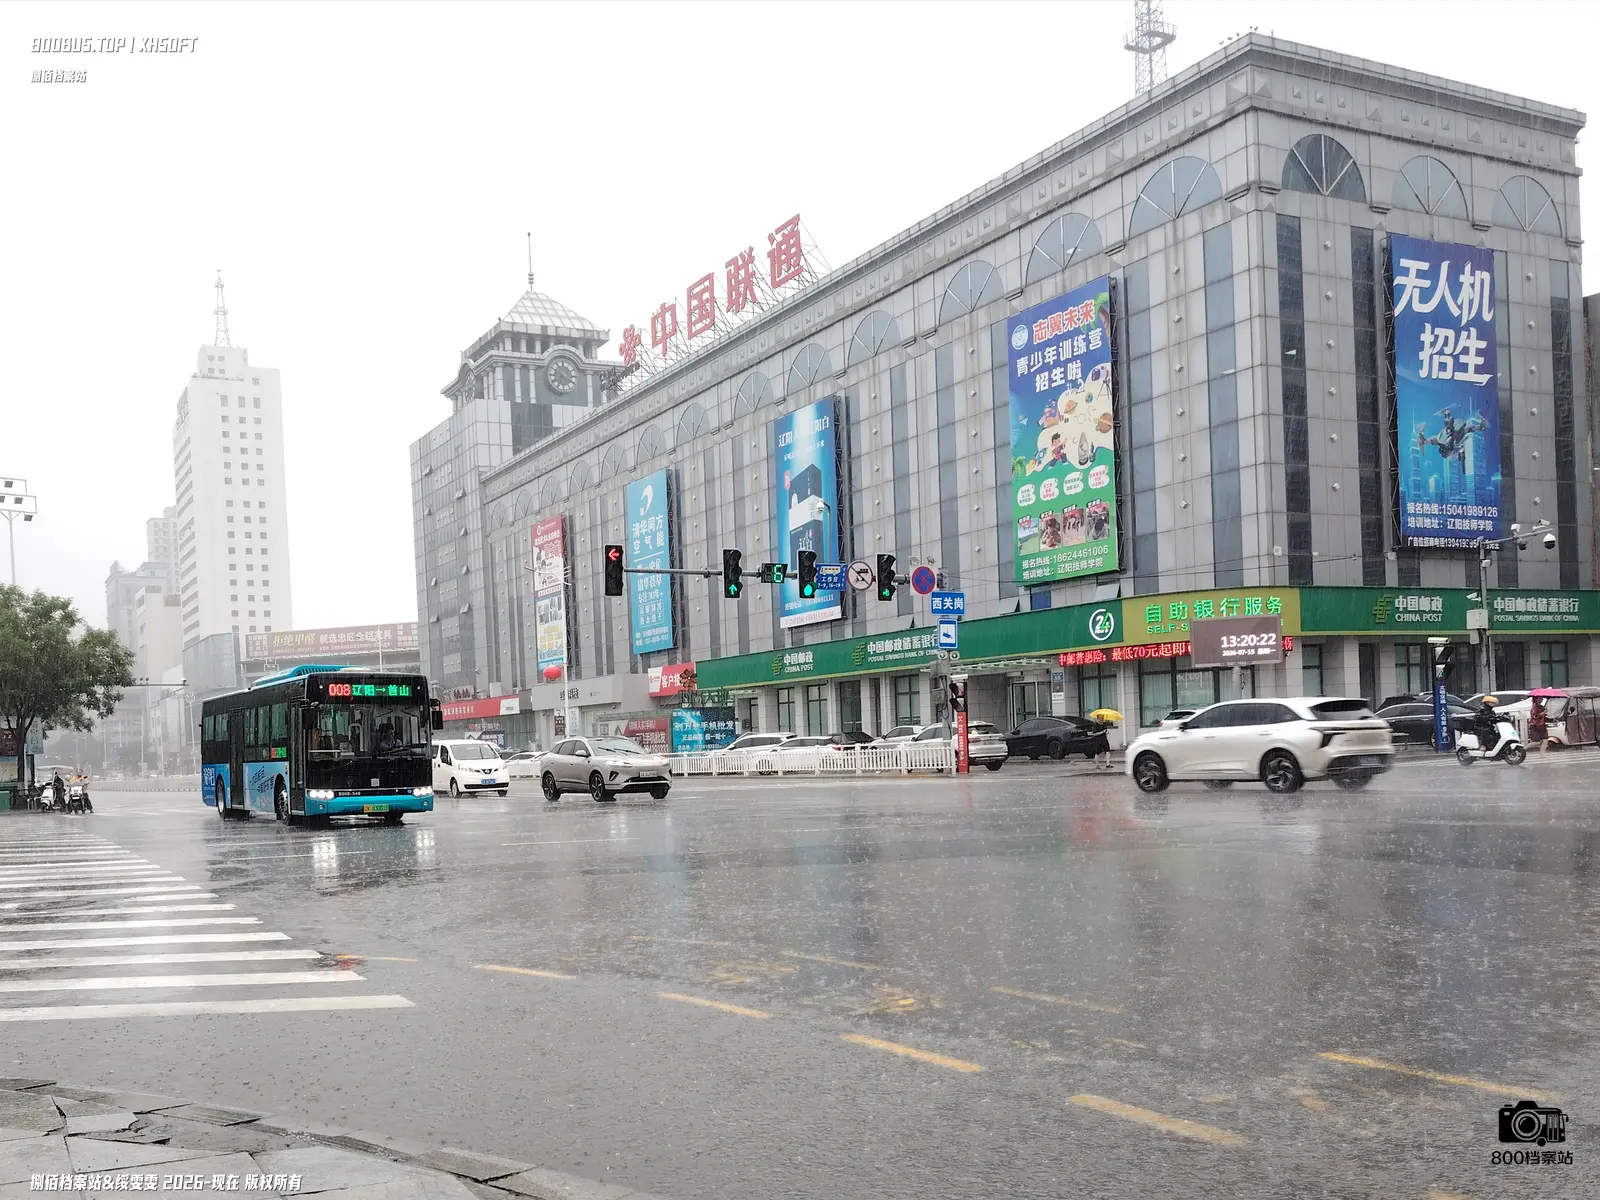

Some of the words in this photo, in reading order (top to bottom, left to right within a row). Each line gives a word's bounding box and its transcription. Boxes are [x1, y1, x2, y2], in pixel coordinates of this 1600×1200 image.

[651, 213, 804, 358] 中国联通
[1393, 258, 1494, 328] 无人机
[1032, 299, 1096, 345] 志翼未来
[1016, 328, 1103, 378] 青少年训练营
[1418, 322, 1494, 387] 招生
[1035, 360, 1082, 393] 招生啦
[1406, 502, 1498, 518] 报名热线:15041989126
[632, 513, 664, 538] 清华同方
[633, 530, 665, 555] 空气能
[1022, 544, 1109, 569] 报名热线:18624461006
[773, 564, 784, 583] 6
[931, 597, 965, 610] 西关岗
[1145, 596, 1283, 624] 自助银行服务
[1394, 595, 1443, 612] 中国邮政
[1493, 597, 1580, 613] 中国邮政储蓄银行
[1395, 614, 1421, 622] CHINA
[1422, 614, 1442, 622] POST
[867, 633, 939, 655] 中国邮政储蓄银行
[1220, 633, 1277, 648] 13:20:22
[783, 650, 814, 666] 中国邮政
[784, 665, 800, 673] CHINA
[800, 663, 814, 672] POST
[352, 684, 375, 697] 辽阳
[388, 684, 409, 696] 首山
